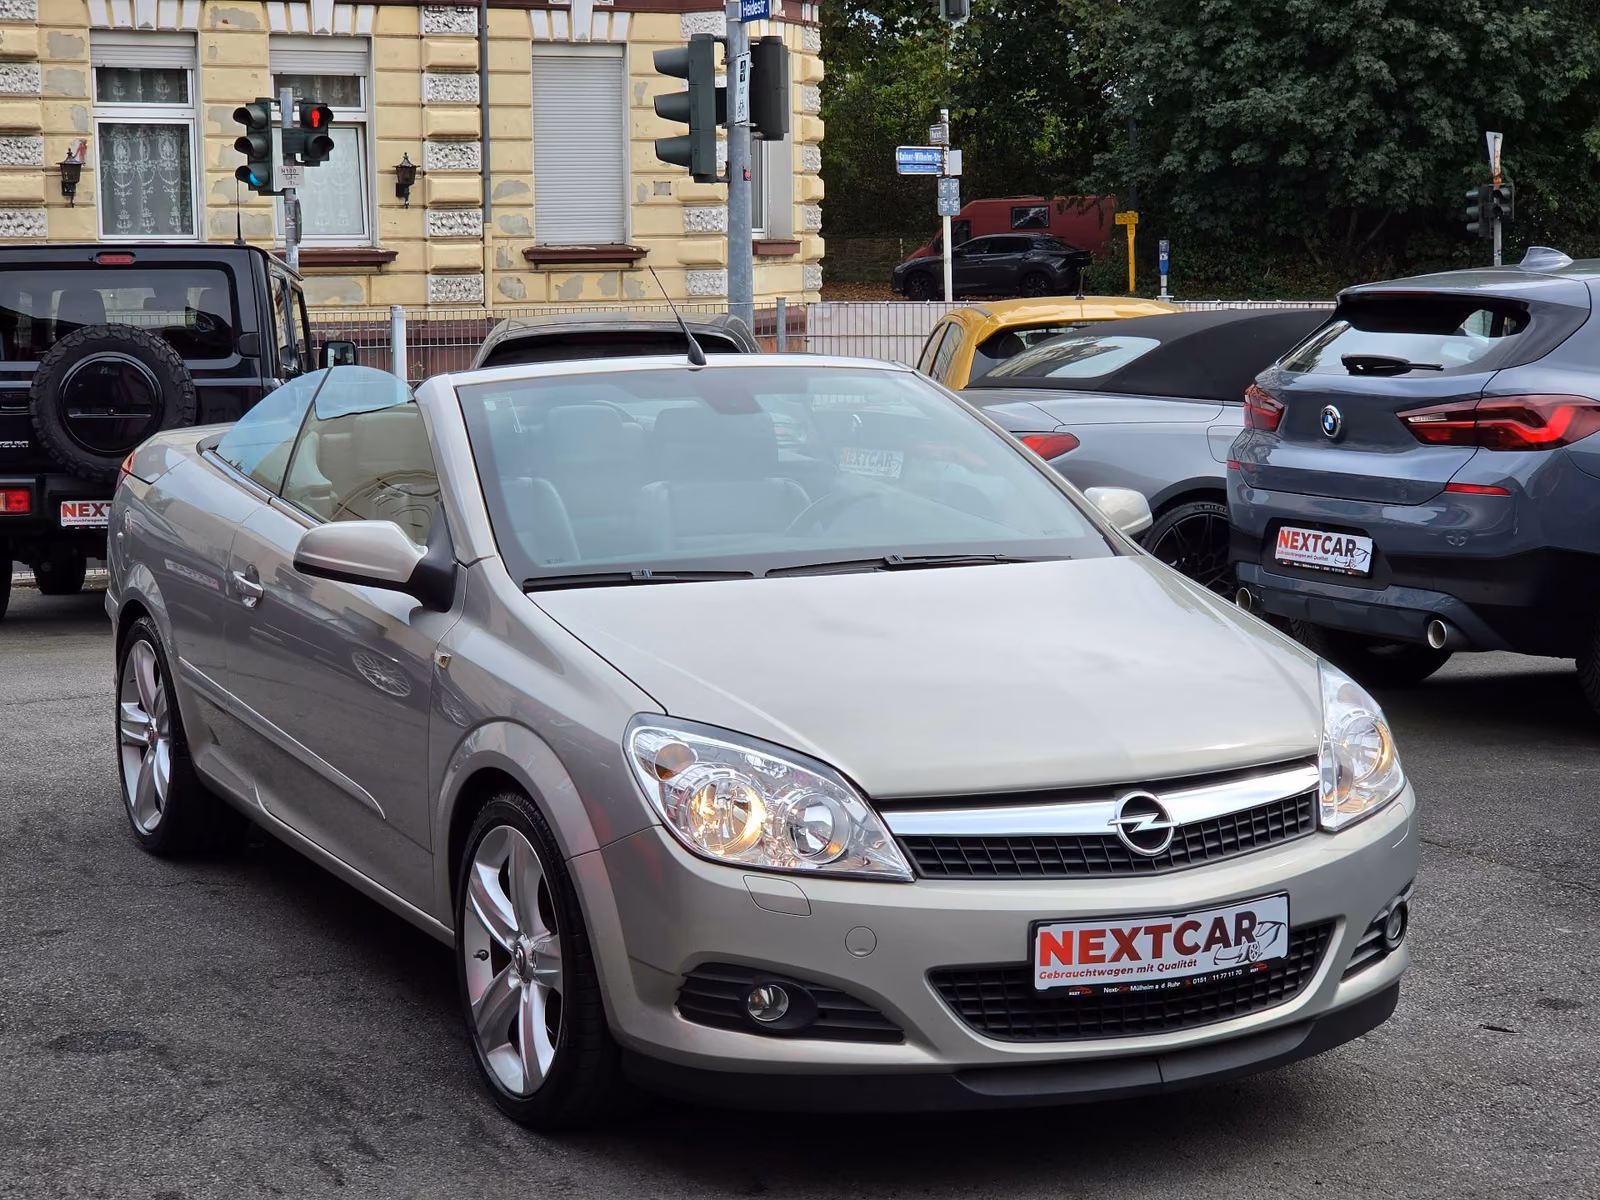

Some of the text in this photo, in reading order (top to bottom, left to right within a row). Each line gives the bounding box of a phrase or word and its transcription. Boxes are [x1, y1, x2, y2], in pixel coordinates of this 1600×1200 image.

[0, 440, 29, 448] ZUKI
[1278, 529, 1357, 558] NEXTCAR
[1039, 910, 1258, 966] NEXTCAR
[1039, 959, 1197, 980] Gebrauchtwagen mit Qualität
[1130, 984, 1154, 992] Mülheim
[1192, 976, 1207, 984] 0151
